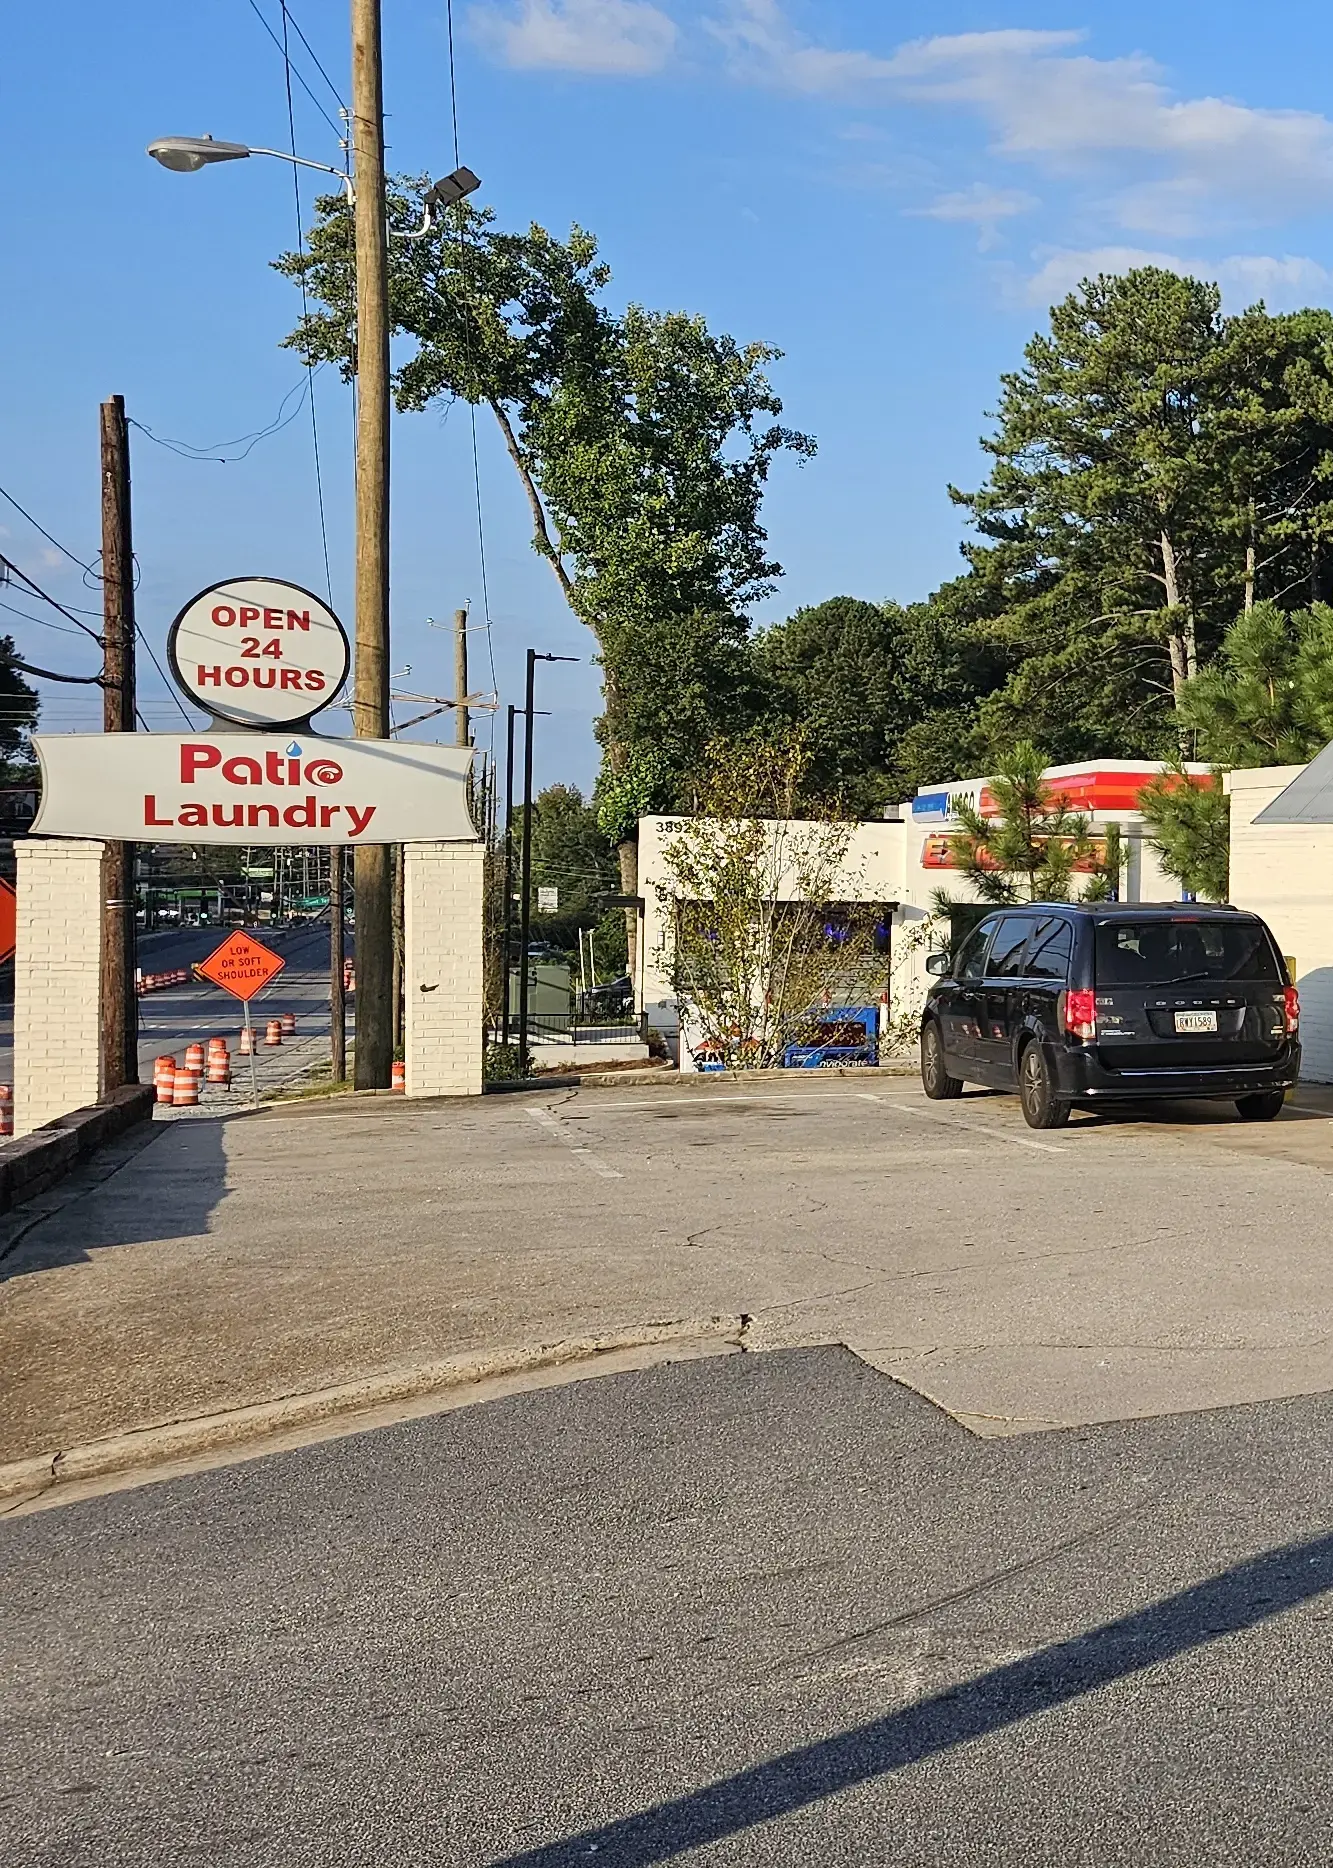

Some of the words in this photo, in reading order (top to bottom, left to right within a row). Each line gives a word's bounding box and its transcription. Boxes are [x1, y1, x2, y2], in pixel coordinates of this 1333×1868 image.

[211, 605, 310, 632] OPEN
[240, 637, 283, 659] 24
[197, 665, 326, 691] HOURS
[180, 740, 344, 787] Patio
[144, 795, 377, 837] Laundry
[655, 820, 692, 834] 3892
[230, 946, 250, 956] LOW
[221, 959, 235, 968] OR
[238, 957, 261, 966] SOFT
[217, 968, 269, 980] SHOULDER
